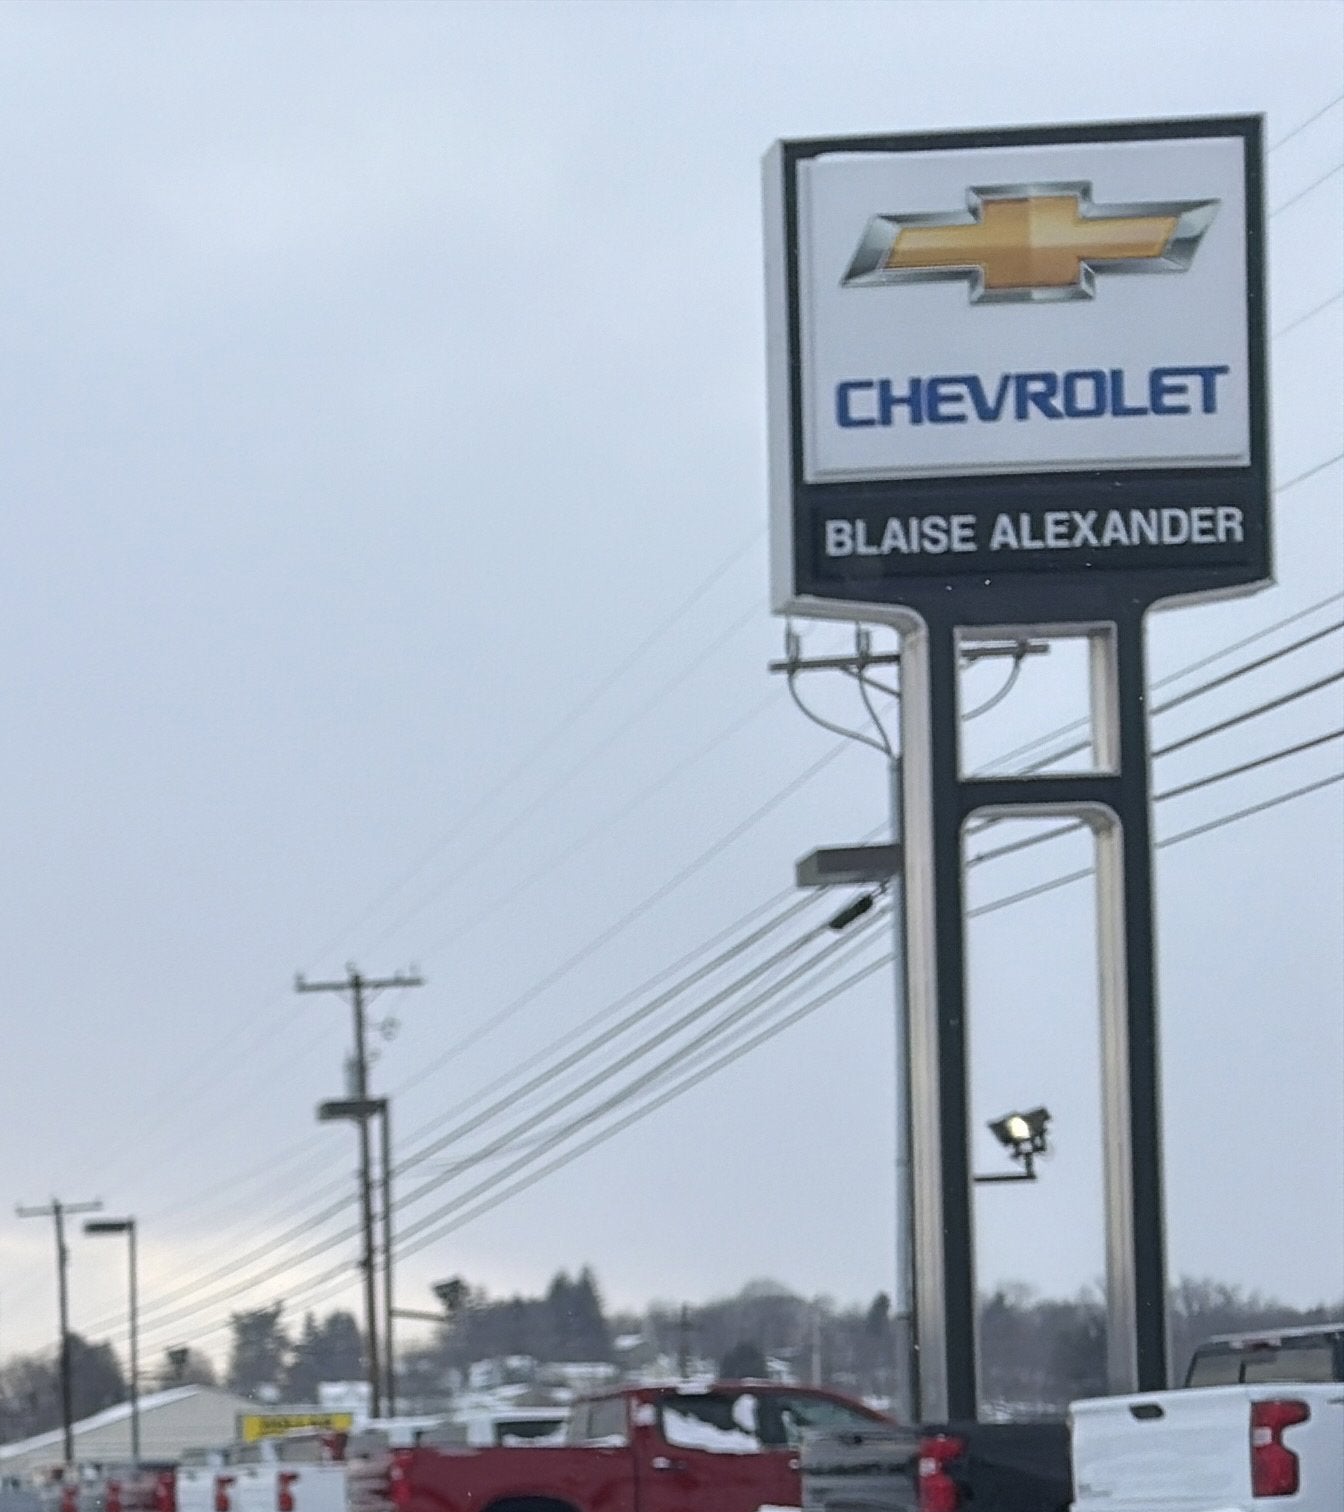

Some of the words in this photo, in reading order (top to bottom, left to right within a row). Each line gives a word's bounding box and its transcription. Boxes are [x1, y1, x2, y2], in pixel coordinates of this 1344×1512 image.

[835, 365, 1229, 428] CHEVROLET
[825, 514, 977, 557] BLAISE
[989, 506, 1244, 551] ALEXANDER
